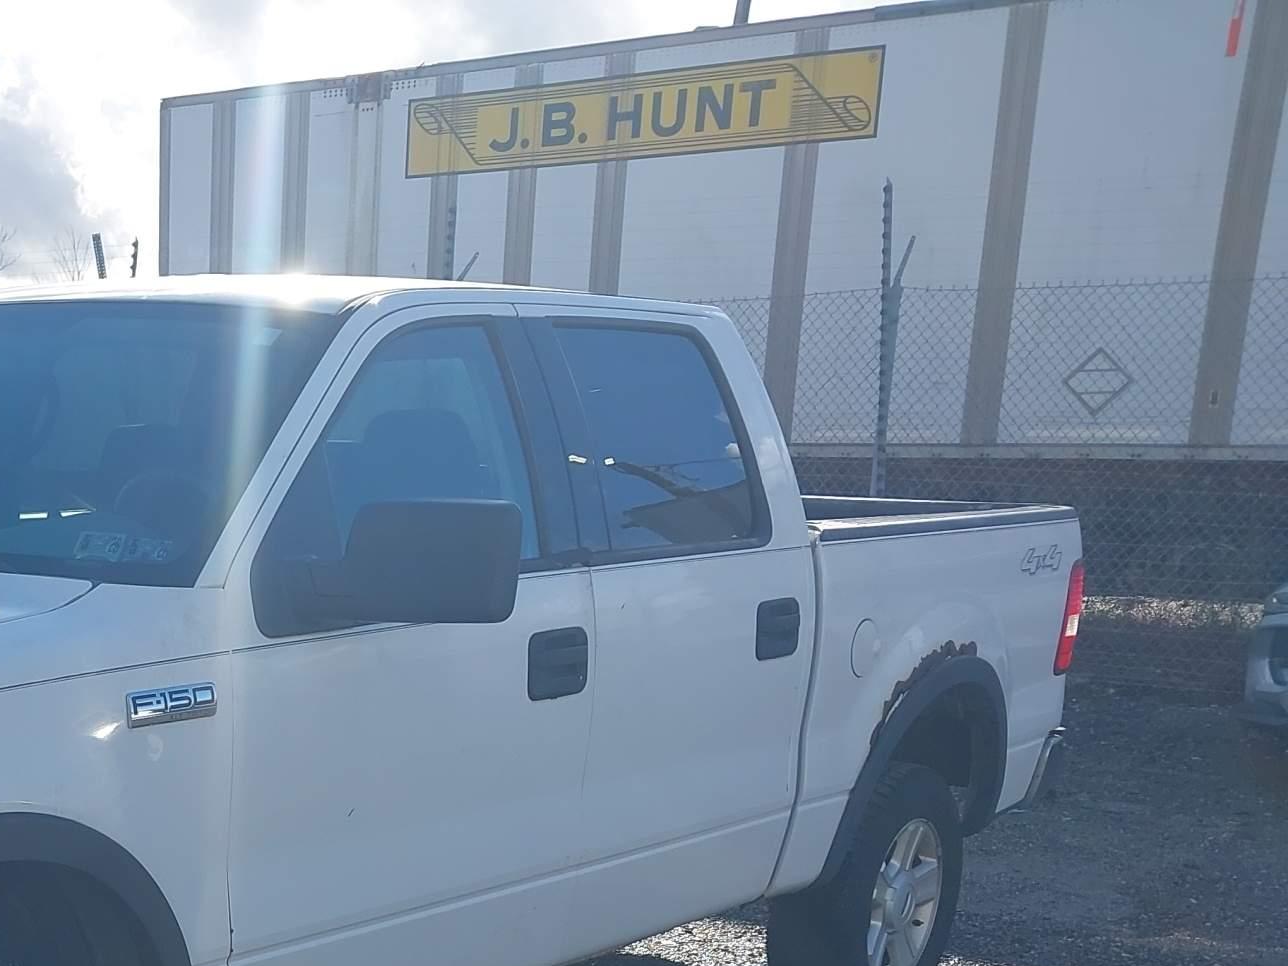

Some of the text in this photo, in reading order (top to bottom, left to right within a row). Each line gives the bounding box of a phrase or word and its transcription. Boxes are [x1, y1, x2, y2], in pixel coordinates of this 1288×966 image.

[488, 78, 777, 152] J.B. HUNT
[131, 684, 216, 716] F-150
